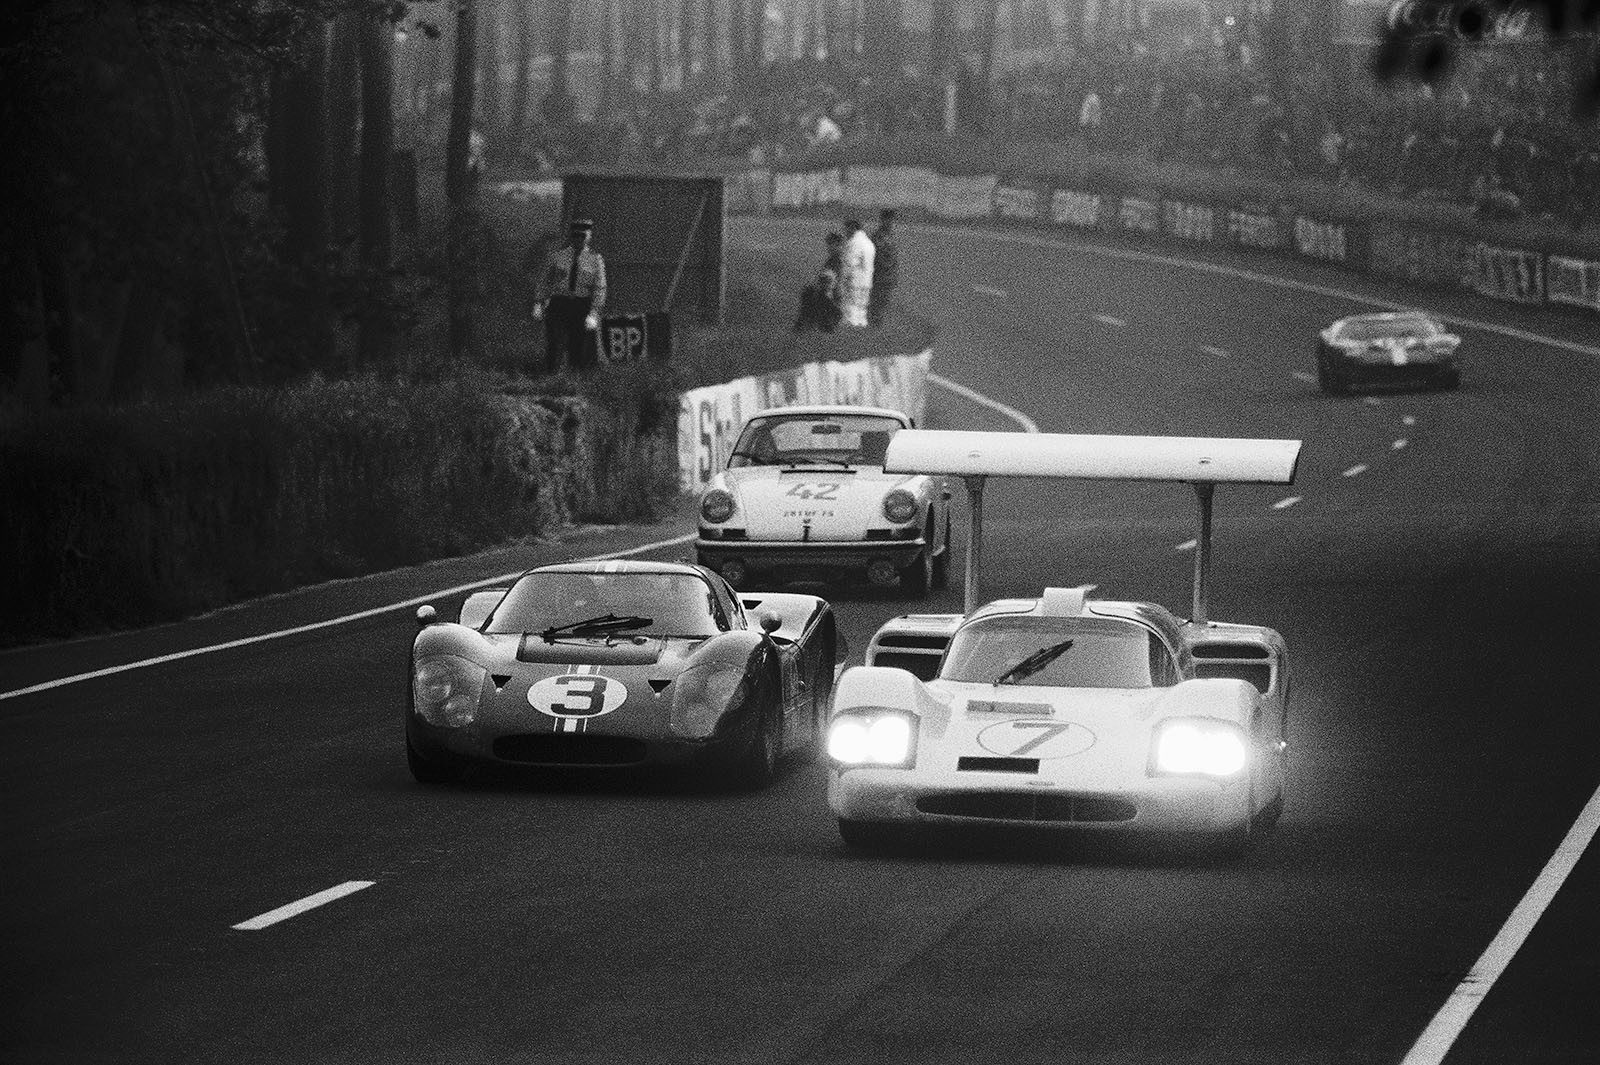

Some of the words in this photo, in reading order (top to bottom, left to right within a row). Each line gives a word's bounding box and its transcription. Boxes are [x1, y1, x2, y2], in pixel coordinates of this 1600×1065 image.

[609, 327, 641, 360] BP
[786, 483, 840, 500] 42
[550, 675, 608, 716] 3
[1009, 722, 1070, 755] 7
